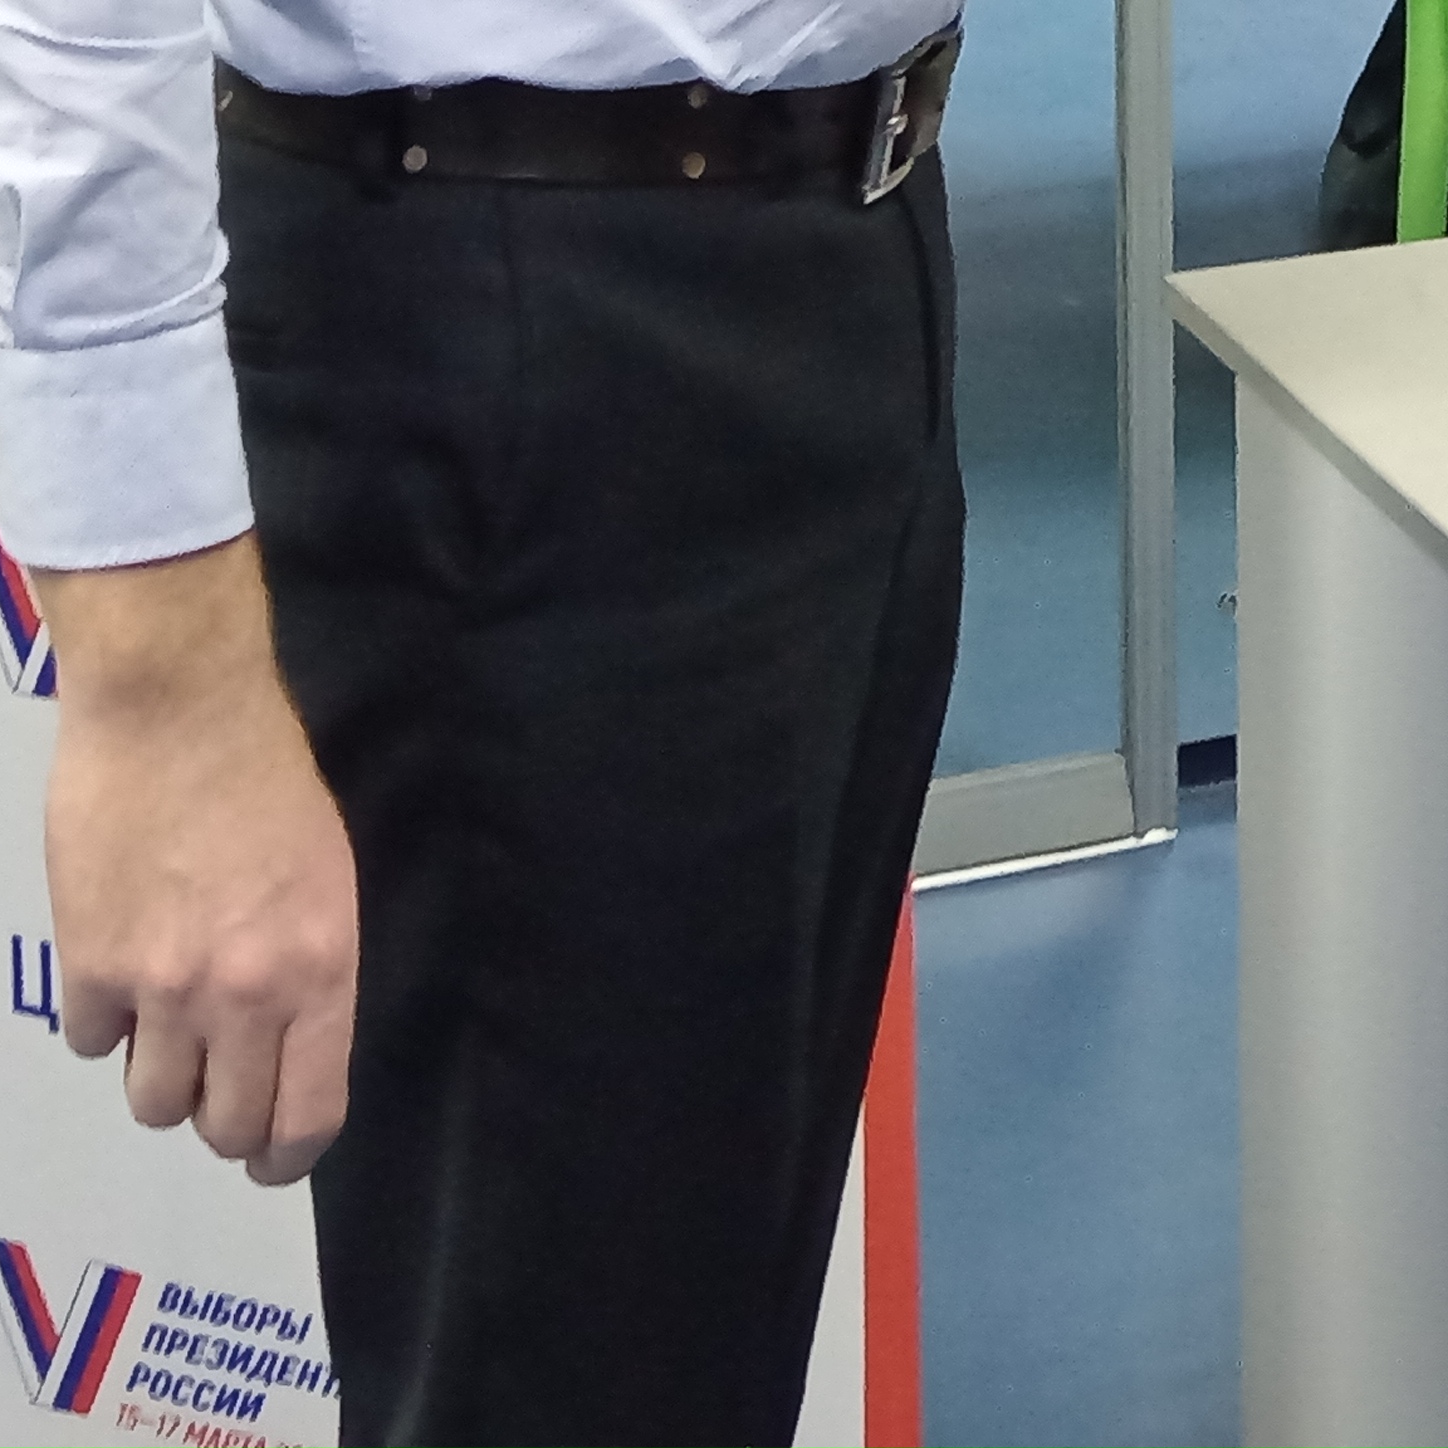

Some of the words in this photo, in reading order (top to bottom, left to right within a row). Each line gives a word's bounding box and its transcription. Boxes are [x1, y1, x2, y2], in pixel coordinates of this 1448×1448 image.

[157, 1282, 313, 1345] ВЫБОРЫ
[126, 1361, 266, 1422] РОССИИ
[142, 1322, 341, 1399] ПРЕЗИДЕН
